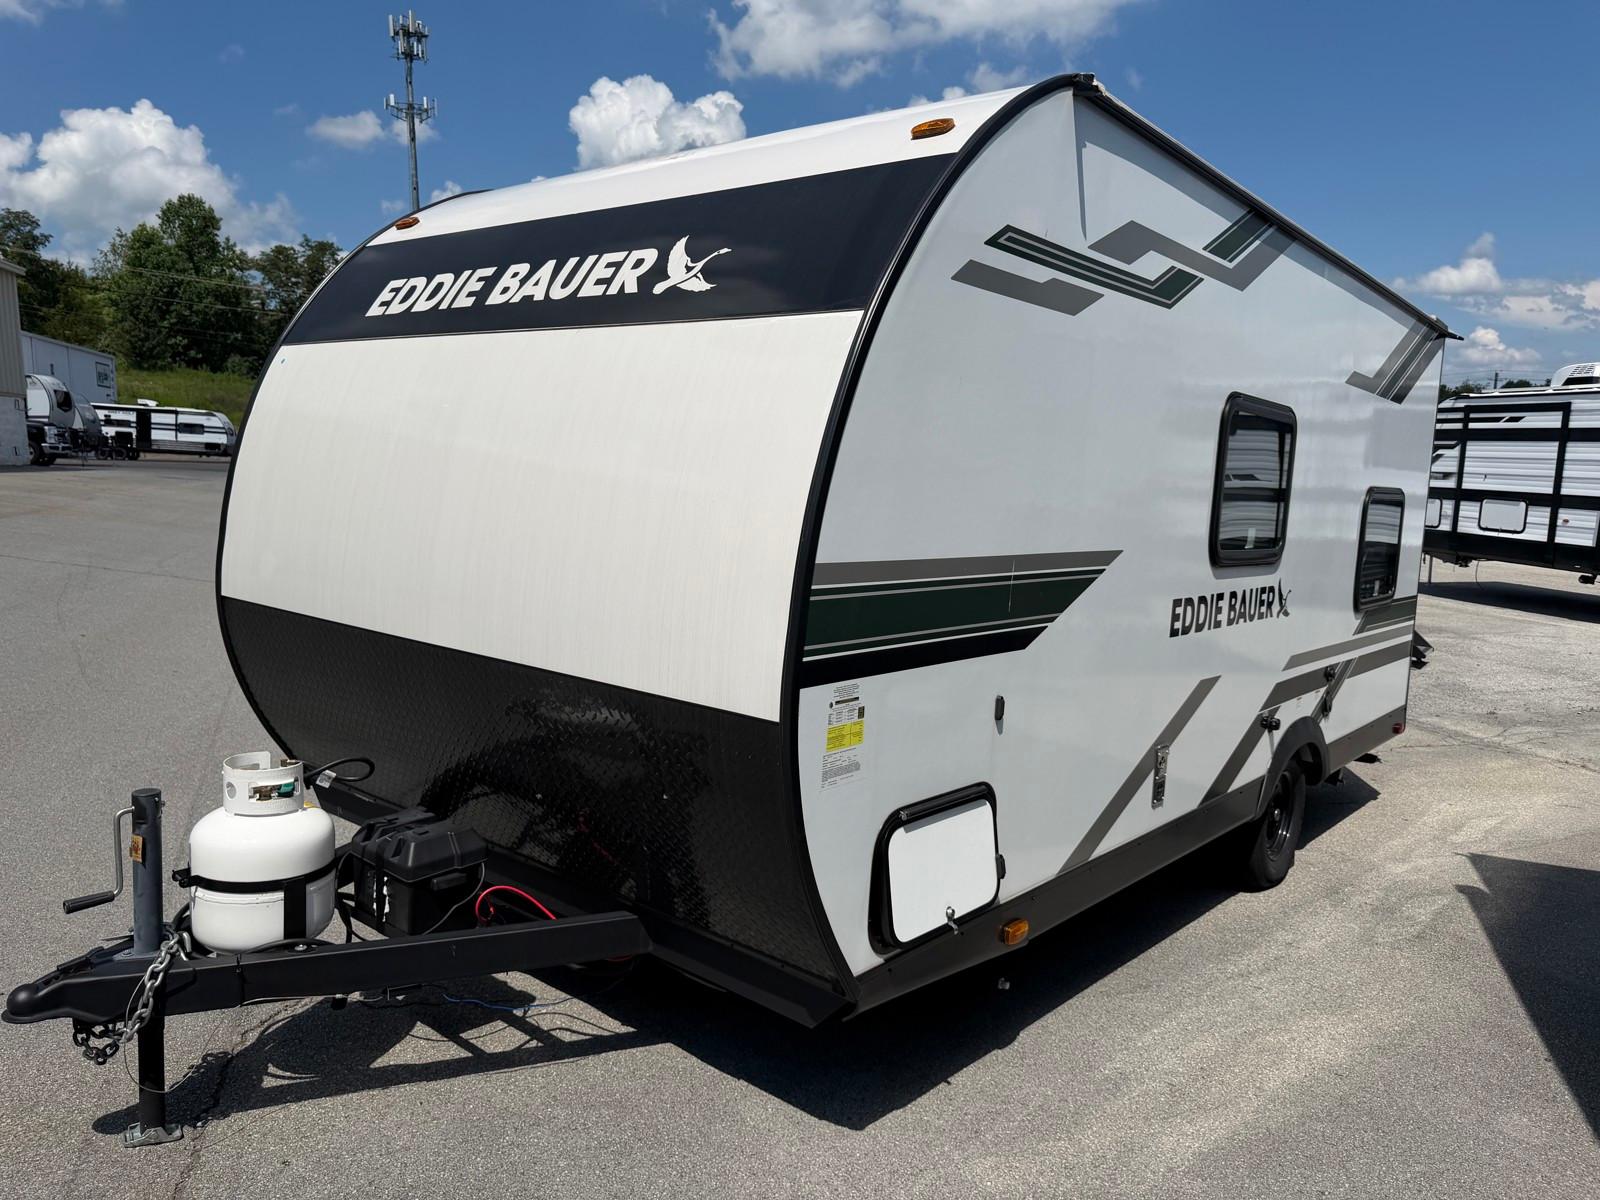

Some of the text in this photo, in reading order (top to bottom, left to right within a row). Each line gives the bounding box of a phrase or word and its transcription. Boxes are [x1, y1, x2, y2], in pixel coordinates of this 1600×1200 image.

[365, 248, 659, 317] EDDIE BAUER
[1169, 585, 1275, 638] EDDIE BAUER
